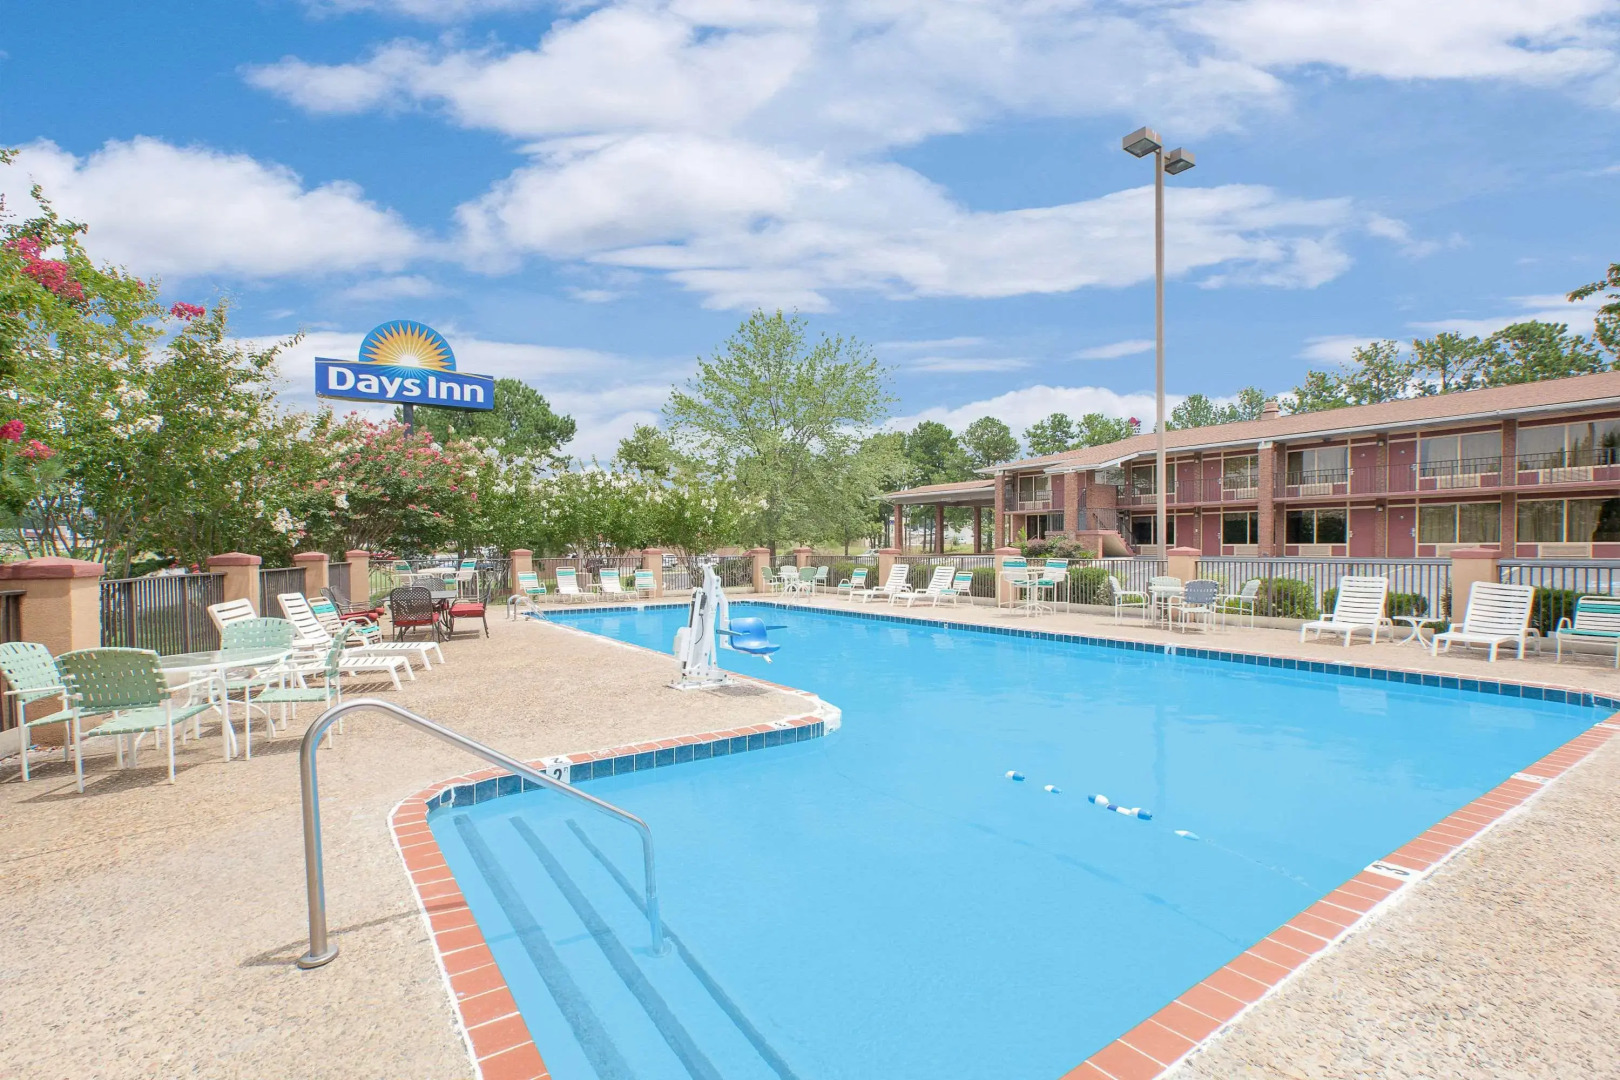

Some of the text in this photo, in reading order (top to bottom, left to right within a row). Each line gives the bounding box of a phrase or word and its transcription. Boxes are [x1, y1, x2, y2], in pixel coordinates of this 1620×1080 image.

[328, 366, 485, 403] Days Inn
[553, 768, 562, 781] 2
